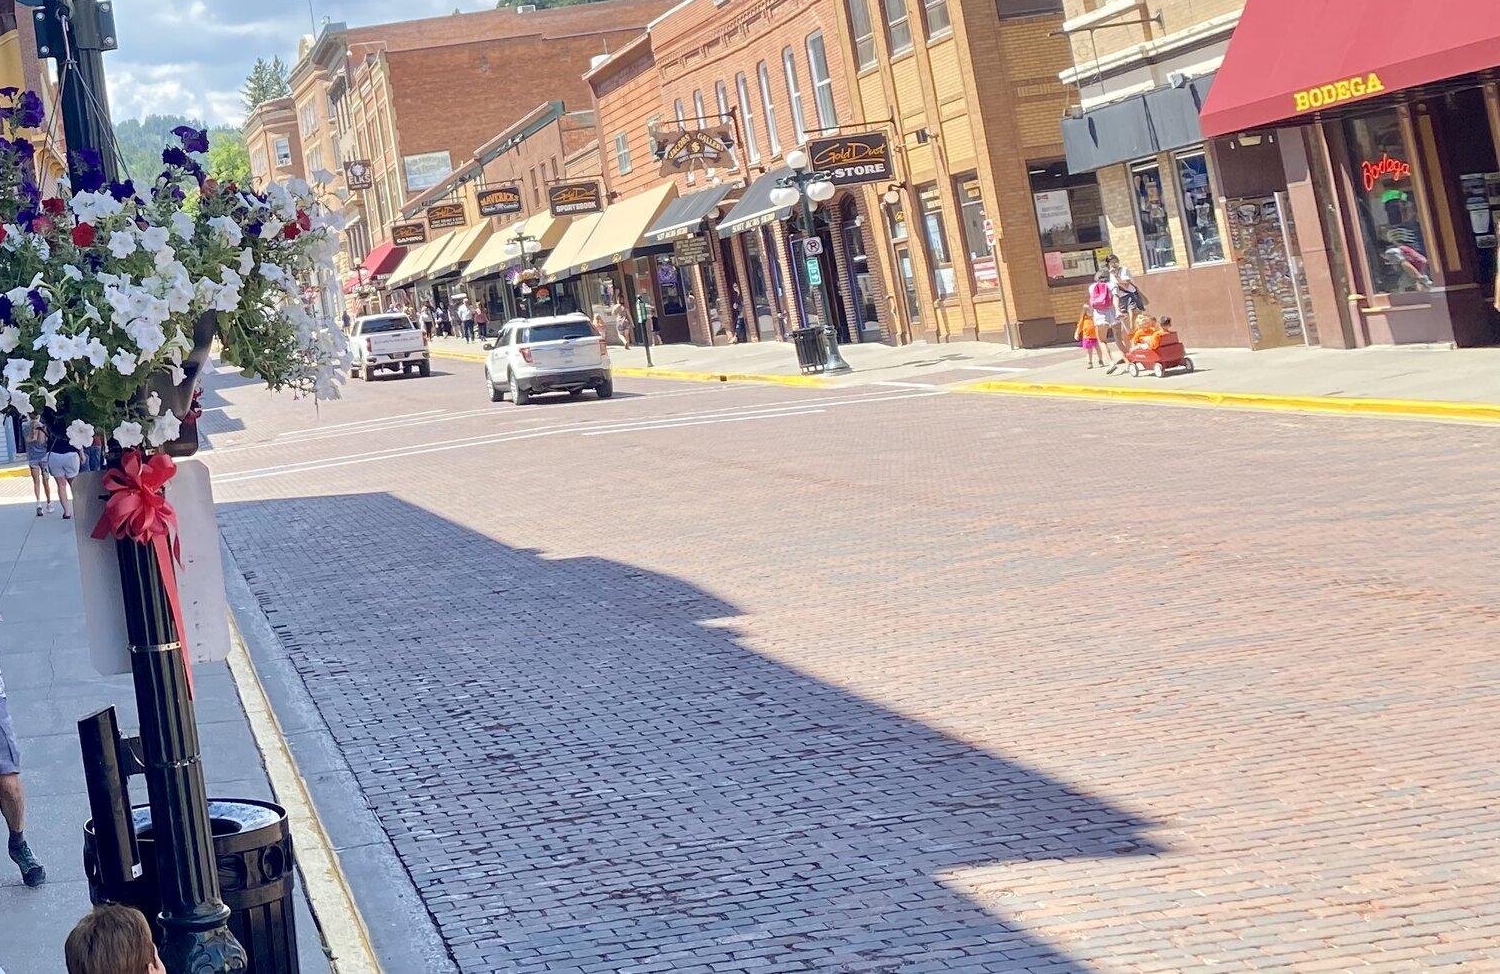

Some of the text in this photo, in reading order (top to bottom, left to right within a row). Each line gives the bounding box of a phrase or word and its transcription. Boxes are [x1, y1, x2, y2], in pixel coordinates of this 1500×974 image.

[1294, 73, 1385, 111] BODEGA
[814, 142, 886, 164] Gold Dust
[348, 174, 372, 185] ELKS
[1361, 153, 1411, 191] Bodega
[397, 235, 424, 244] GAMING
